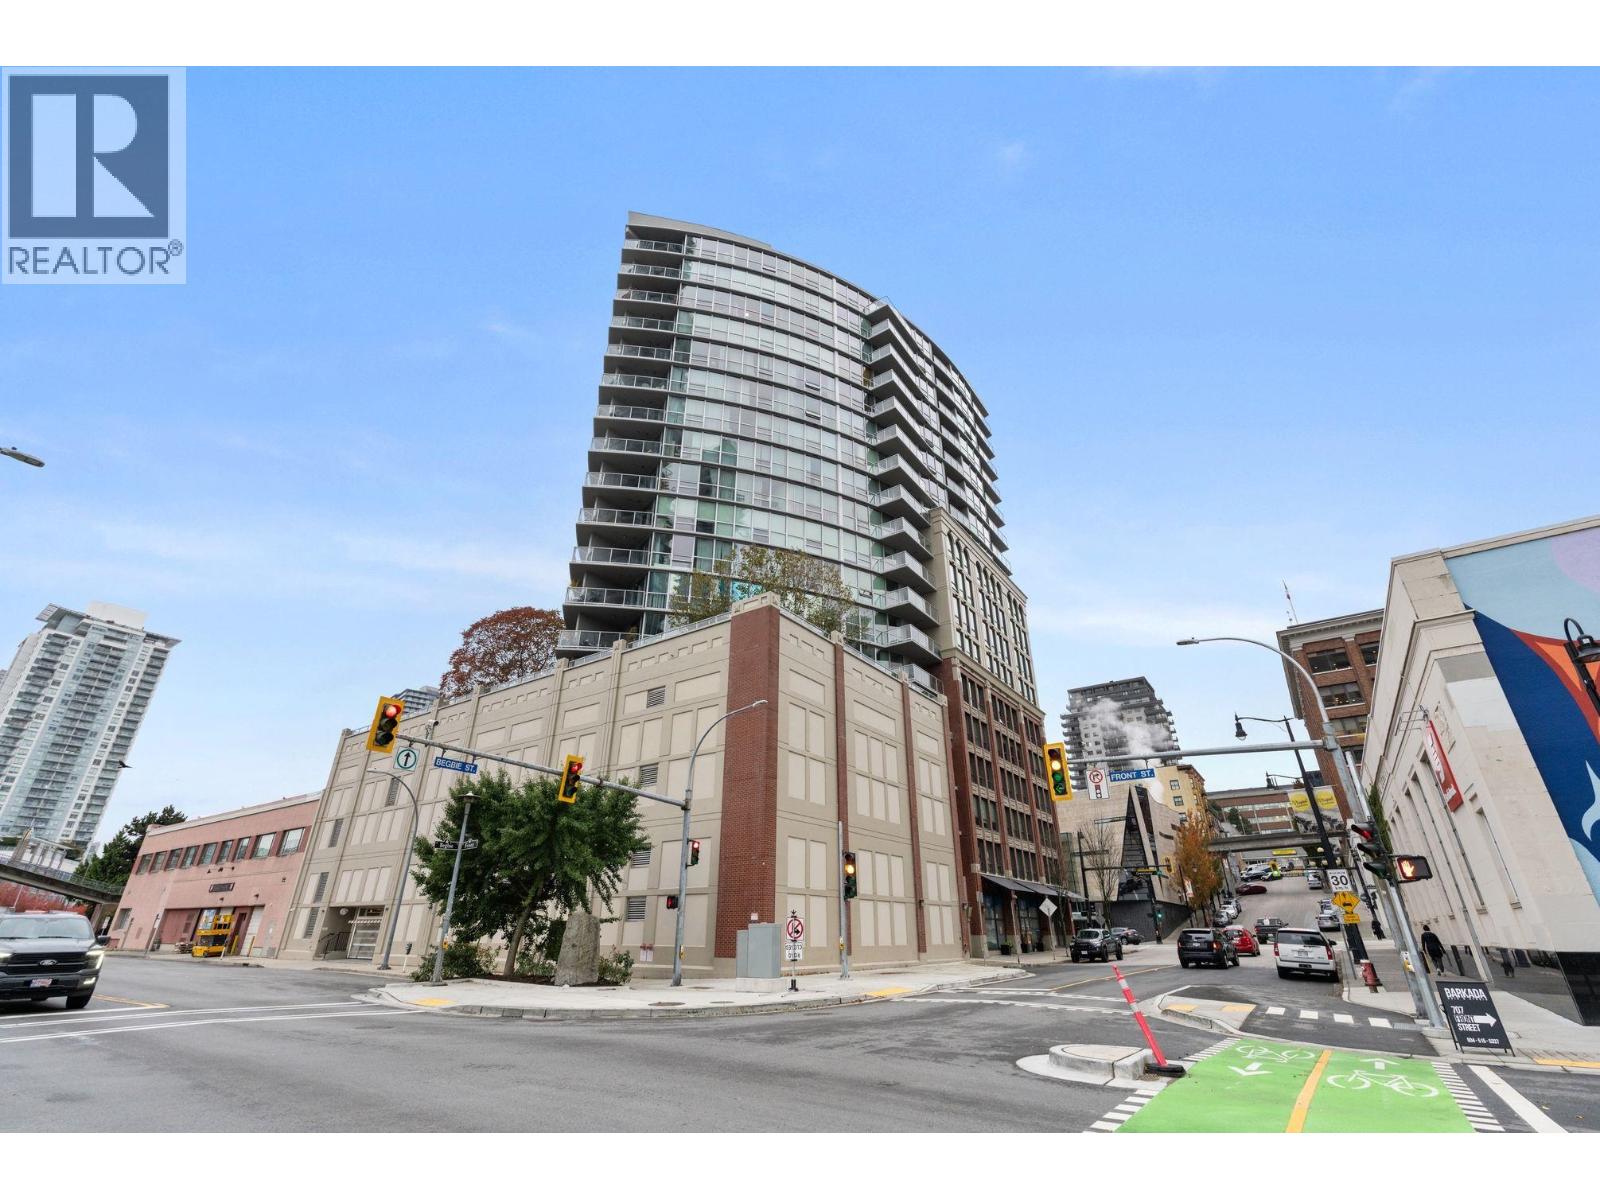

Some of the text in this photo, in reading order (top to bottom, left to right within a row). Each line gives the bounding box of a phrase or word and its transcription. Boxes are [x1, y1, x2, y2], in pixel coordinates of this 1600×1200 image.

[436, 758, 476, 773] BEGBIE ST.
[1110, 769, 1154, 781] FRONT ST.
[1330, 875, 1349, 886] 30
[1444, 987, 1488, 1001] BARKADA
[1457, 1023, 1481, 1032] STREET
